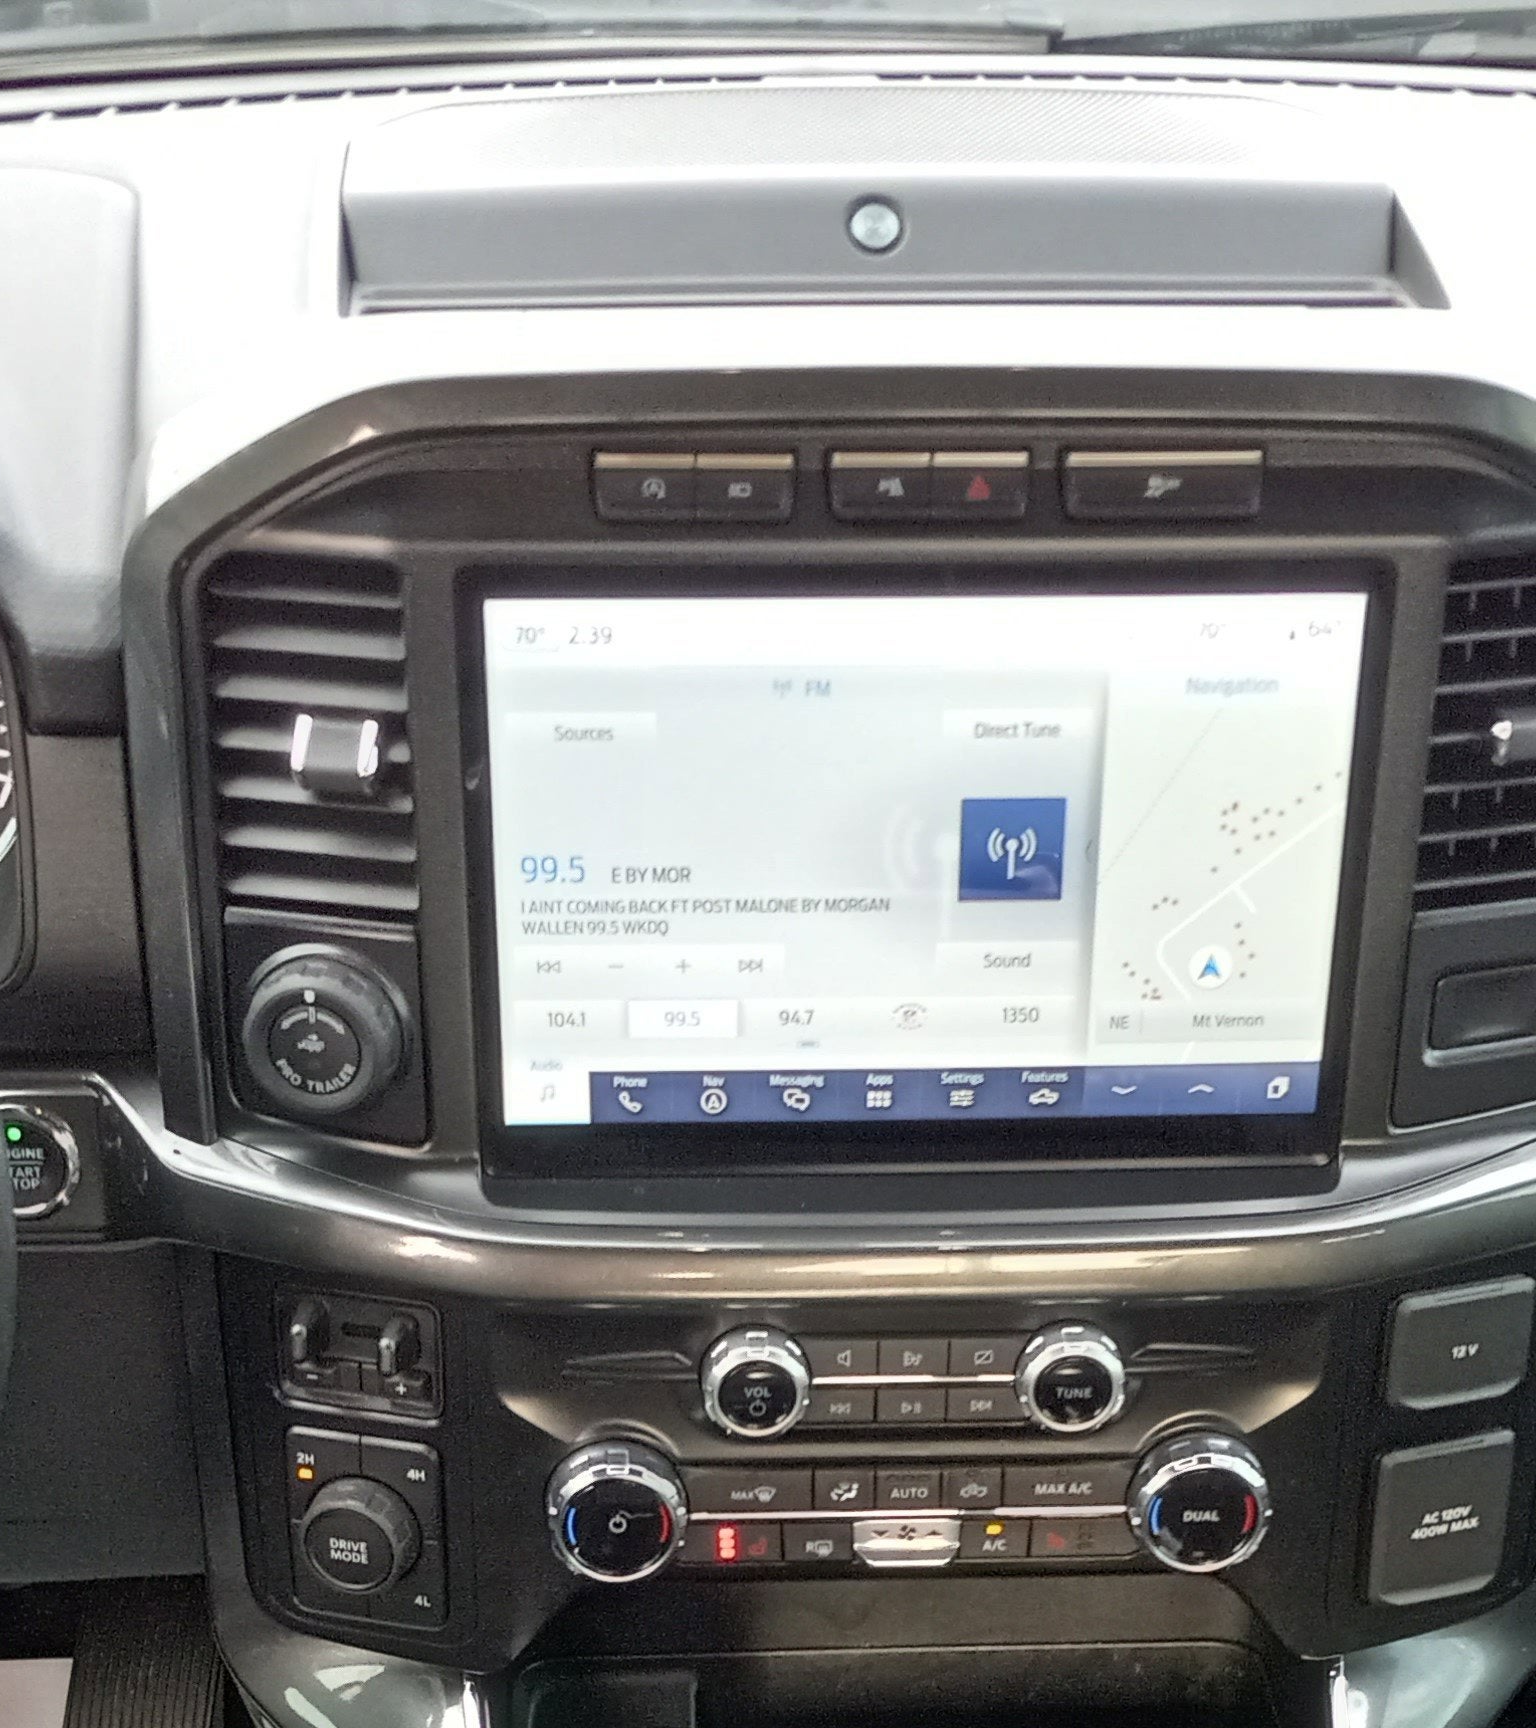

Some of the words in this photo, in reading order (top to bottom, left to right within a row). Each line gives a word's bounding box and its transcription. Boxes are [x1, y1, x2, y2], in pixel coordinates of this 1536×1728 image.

[805, 679, 831, 697] FM
[1185, 676, 1280, 698] Navigation
[554, 724, 614, 742] Sources
[974, 722, 1019, 739] Direct
[1022, 722, 1061, 739] Tune
[521, 855, 586, 884] 99.5
[611, 867, 622, 884] E
[626, 867, 648, 884] BY
[652, 867, 691, 884] MOR
[527, 901, 562, 915] AINT
[567, 900, 626, 915] COMING
[628, 900, 667, 914] BACK
[671, 899, 688, 914] FT
[692, 899, 732, 913] POST
[735, 899, 798, 913] MALONE
[802, 898, 821, 912] BY
[824, 897, 890, 913] MORGAN
[522, 920, 584, 936] WALLEN
[587, 920, 620, 935] 99.5
[622, 920, 669, 937] WKDQ
[983, 952, 1031, 970] Sound
[548, 1011, 587, 1027] 104.1
[664, 1011, 702, 1027] 99.5
[779, 1010, 814, 1026] 94.7
[1002, 1007, 1040, 1023] 1350
[1108, 1015, 1130, 1030] NE
[1193, 1013, 1212, 1027] Mt
[1215, 1013, 1264, 1028] Vernon
[275, 1057, 303, 1087] PRO
[306, 1062, 357, 1094] TRAILER
[613, 1075, 647, 1088] Phone
[703, 1075, 725, 1087] Nav
[769, 1074, 825, 1089] Messaging
[866, 1073, 894, 1088] Apps
[940, 1071, 984, 1086] Settings
[1021, 1070, 1068, 1085] Features
[7, 1166, 41, 1179] TART
[11, 1177, 41, 1191] TOP
[743, 1386, 772, 1398] VOL
[1055, 1386, 1094, 1399] TUNE
[296, 1453, 315, 1465] 2H
[406, 1468, 426, 1482] 4H
[730, 1489, 754, 1501] MAX
[890, 1486, 929, 1499] AUTO
[1034, 1484, 1065, 1496] MAX
[1068, 1482, 1093, 1495] A/C
[1182, 1510, 1221, 1523] DUAL
[1421, 1510, 1440, 1526] AC
[1441, 1504, 1472, 1522] 120V
[1410, 1522, 1449, 1540] 400W
[1450, 1516, 1480, 1534] MAX
[330, 1537, 368, 1554] DRIVE
[981, 1538, 1007, 1552] A/C
[330, 1549, 369, 1565] MODE
[414, 1595, 431, 1608] 4L
